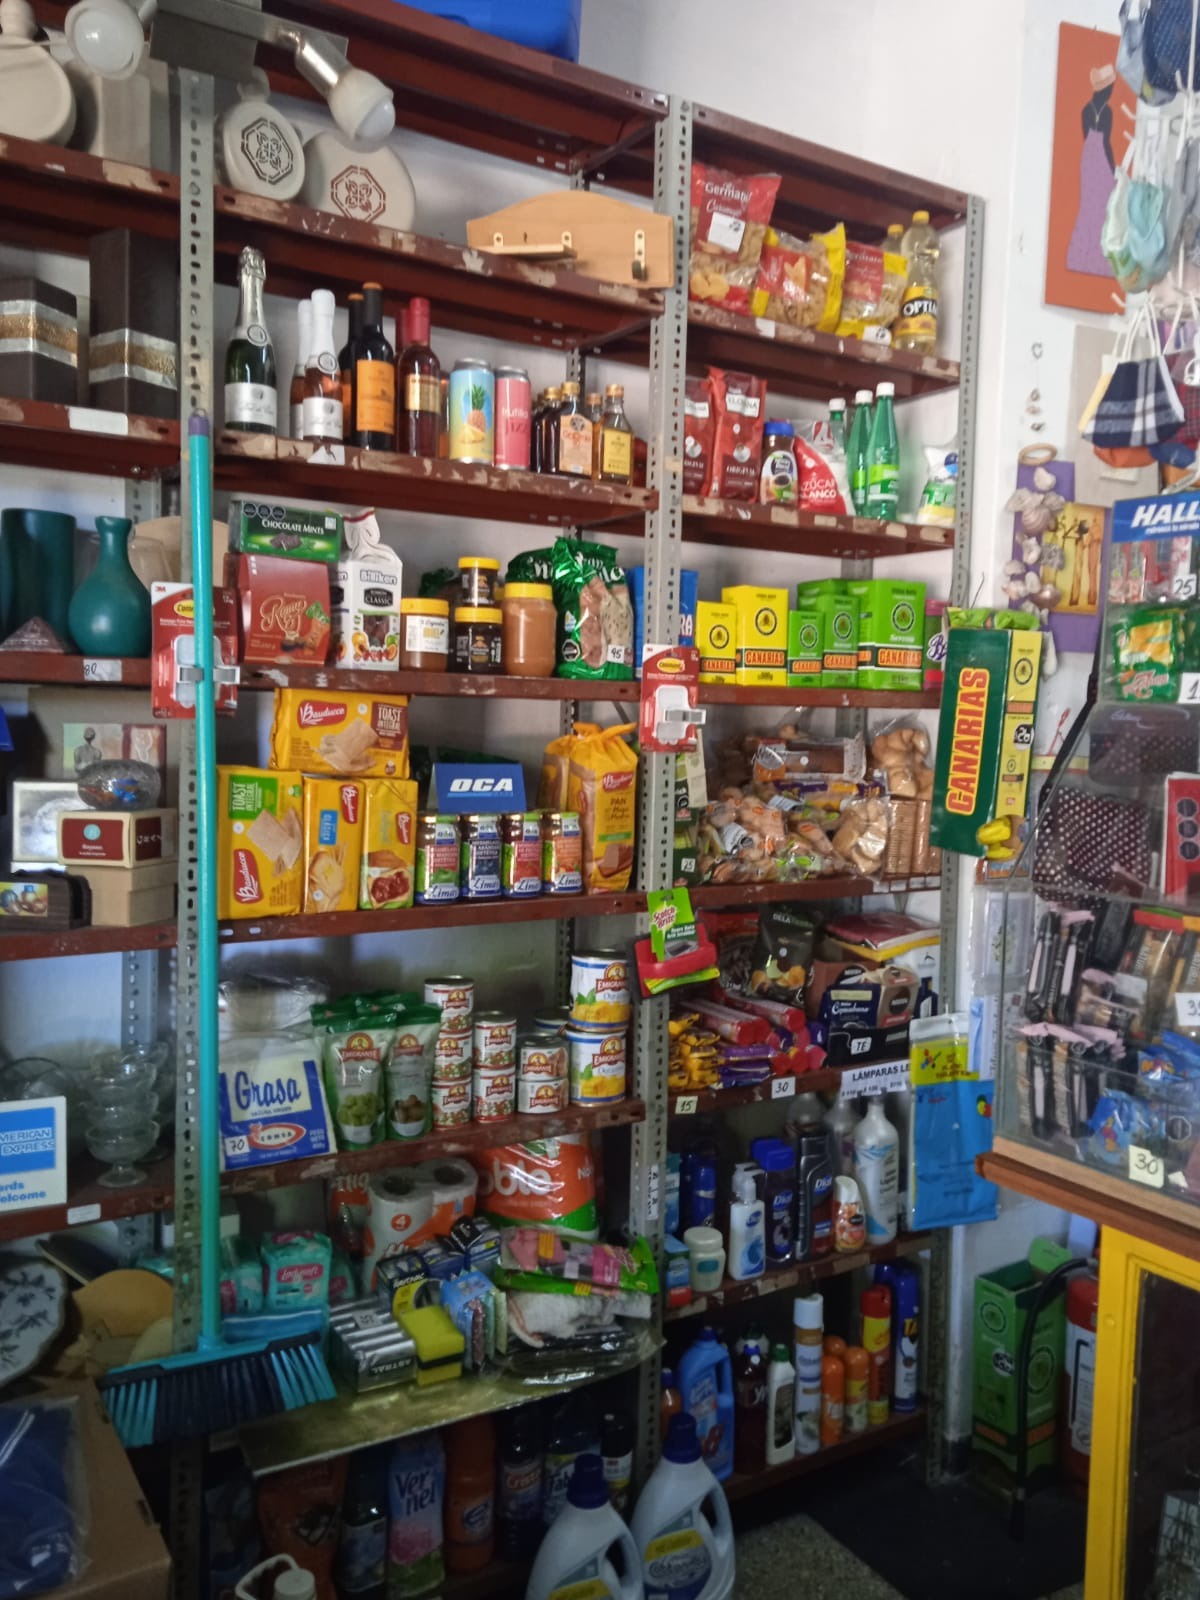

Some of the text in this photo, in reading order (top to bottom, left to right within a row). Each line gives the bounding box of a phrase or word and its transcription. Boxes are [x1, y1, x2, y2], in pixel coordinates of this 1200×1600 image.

[1131, 500, 1200, 528] HALL
[261, 520, 325, 535] CHOCOLATE MINTS
[360, 569, 398, 586] Billiken
[365, 594, 393, 607] CLASSIC
[745, 650, 786, 666] CANARIAS
[878, 648, 922, 667] CANARIAS
[300, 702, 346, 725] Bauducco
[377, 706, 402, 721] TOAST
[947, 668, 989, 815] CANARIAS
[450, 778, 513, 792] OCA
[231, 782, 247, 812] TOAST
[236, 851, 260, 902] Bauducco
[653, 905, 676, 924] Scotch
[656, 914, 676, 930] Brite
[900, 1063, 911, 1073] LE
[234, 1071, 302, 1112] Grasa
[775, 1081, 789, 1093] 30
[0, 1128, 52, 1143] MERICAN
[2, 1141, 56, 1155] EXPRESS
[229, 1139, 245, 1152] 70
[1135, 1153, 1158, 1175] 30
[0, 1181, 25, 1192] ards
[0, 1190, 47, 1204] elcome
[395, 1470, 430, 1498] Ver
[405, 1481, 436, 1516] nel
